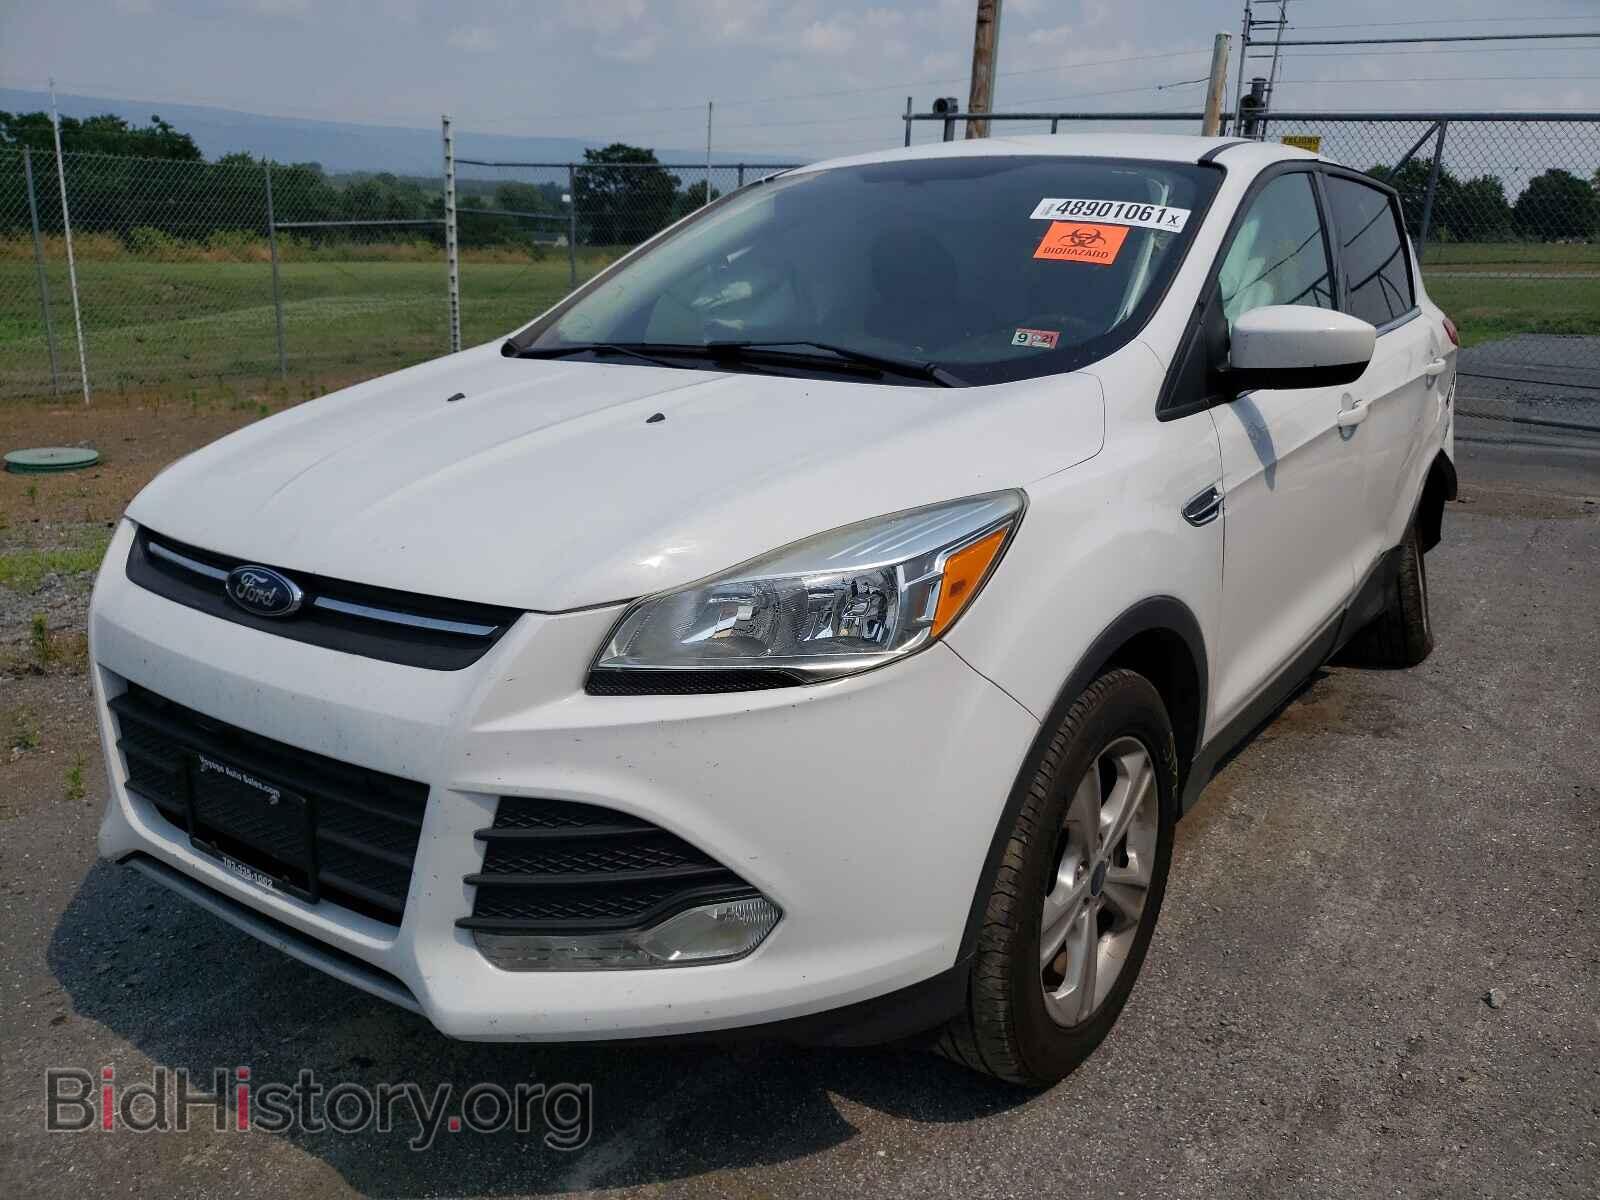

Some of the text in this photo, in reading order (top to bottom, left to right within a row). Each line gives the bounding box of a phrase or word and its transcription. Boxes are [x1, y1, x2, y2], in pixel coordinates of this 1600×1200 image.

[1055, 200, 1167, 224] 48901061
[1043, 246, 1109, 259] BIOHAZARD
[1017, 333, 1028, 343] 9
[236, 572, 278, 607] Ford
